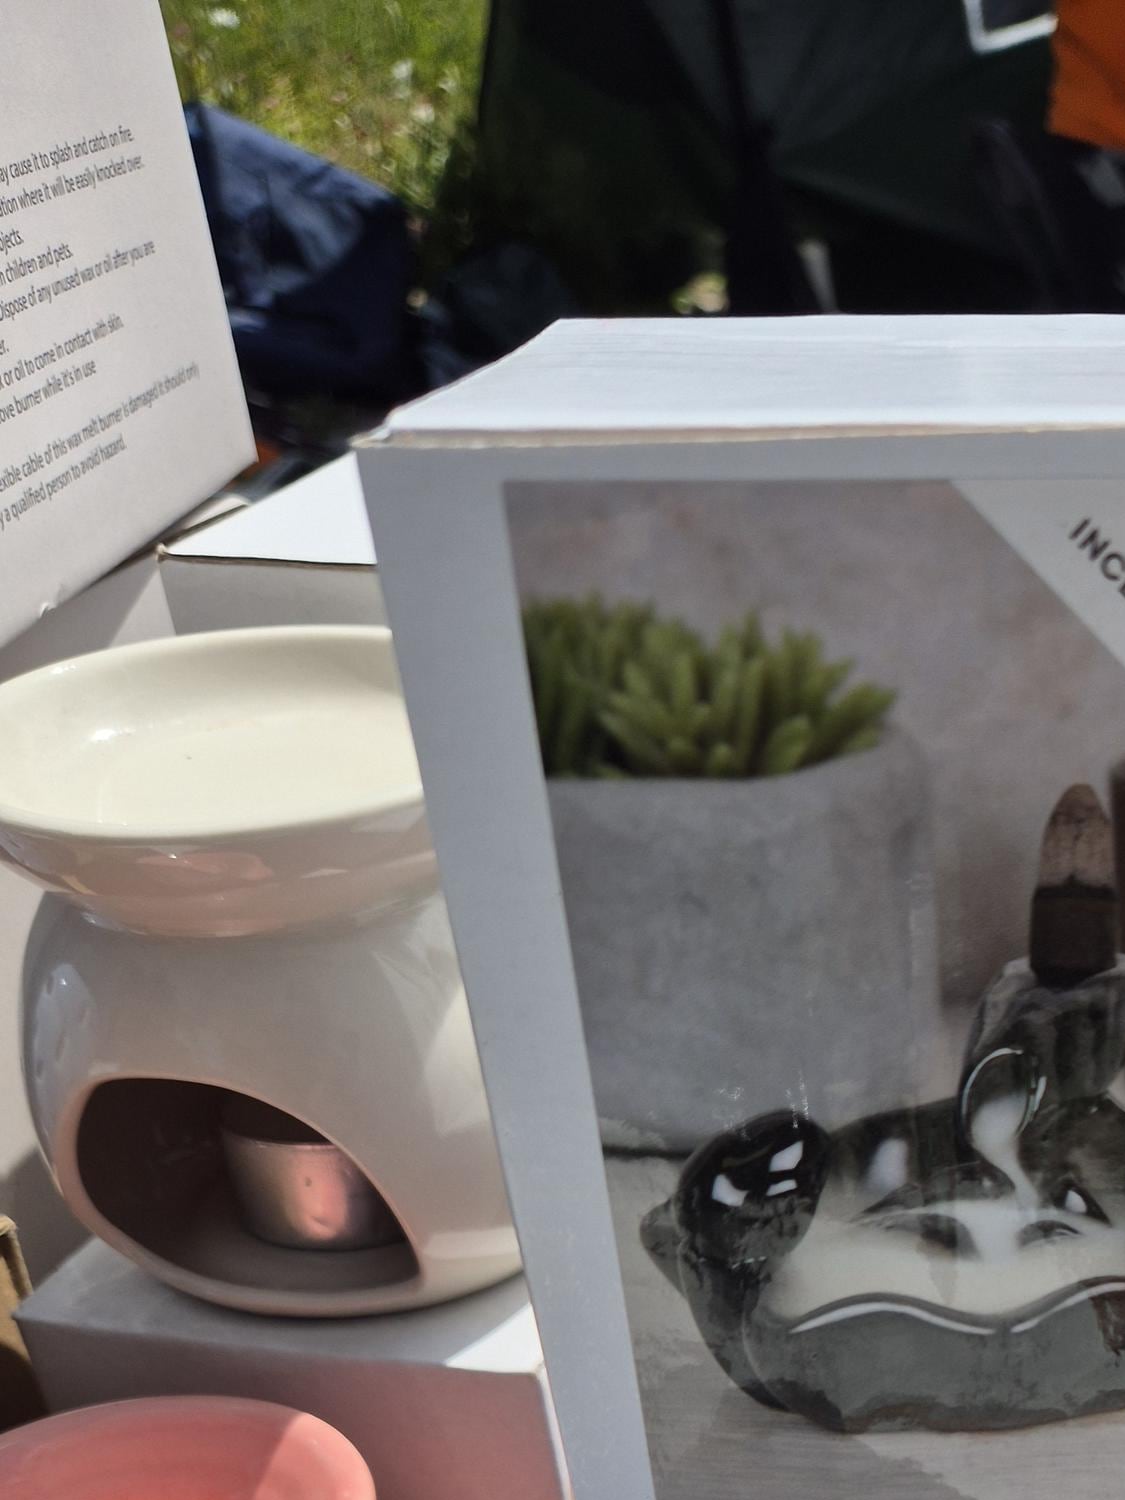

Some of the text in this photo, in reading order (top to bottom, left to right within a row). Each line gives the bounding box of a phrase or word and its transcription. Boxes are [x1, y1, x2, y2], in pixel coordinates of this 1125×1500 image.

[8, 158, 33, 178] cause
[30, 152, 40, 170] it
[38, 151, 50, 168] to
[49, 141, 73, 168] splash
[72, 136, 88, 158] and
[88, 131, 109, 153] catch
[108, 132, 117, 146] on
[17, 187, 44, 208] where
[41, 182, 51, 200] it
[62, 175, 75, 193] be
[74, 167, 96, 189] easily
[93, 158, 126, 181] knocked
[5, 256, 38, 282] children
[36, 245, 53, 269] and
[52, 243, 73, 267] pets.
[27, 285, 37, 306] of
[36, 284, 51, 303] any
[51, 267, 81, 296] unused
[80, 267, 94, 282] wax
[94, 262, 102, 276] or
[102, 253, 112, 273] oil
[143, 241, 155, 256] are
[3, 369, 13, 386] or
[13, 359, 25, 380] oil
[24, 359, 34, 375] to
[34, 349, 56, 370] come
[54, 342, 64, 359] in
[63, 328, 93, 355] contact
[12, 388, 42, 414] burner
[41, 375, 63, 399] while
[60, 369, 74, 387] it's
[72, 365, 82, 381] in
[82, 360, 96, 377] use
[21, 452, 44, 477] cable
[43, 443, 53, 464] of
[51, 439, 67, 459] this
[66, 432, 82, 449] wax
[97, 407, 122, 431] burner
[3, 508, 11, 522] a
[10, 481, 46, 520] qualified
[45, 470, 72, 500] person
[70, 464, 80, 480] to
[79, 447, 101, 474] avoid
